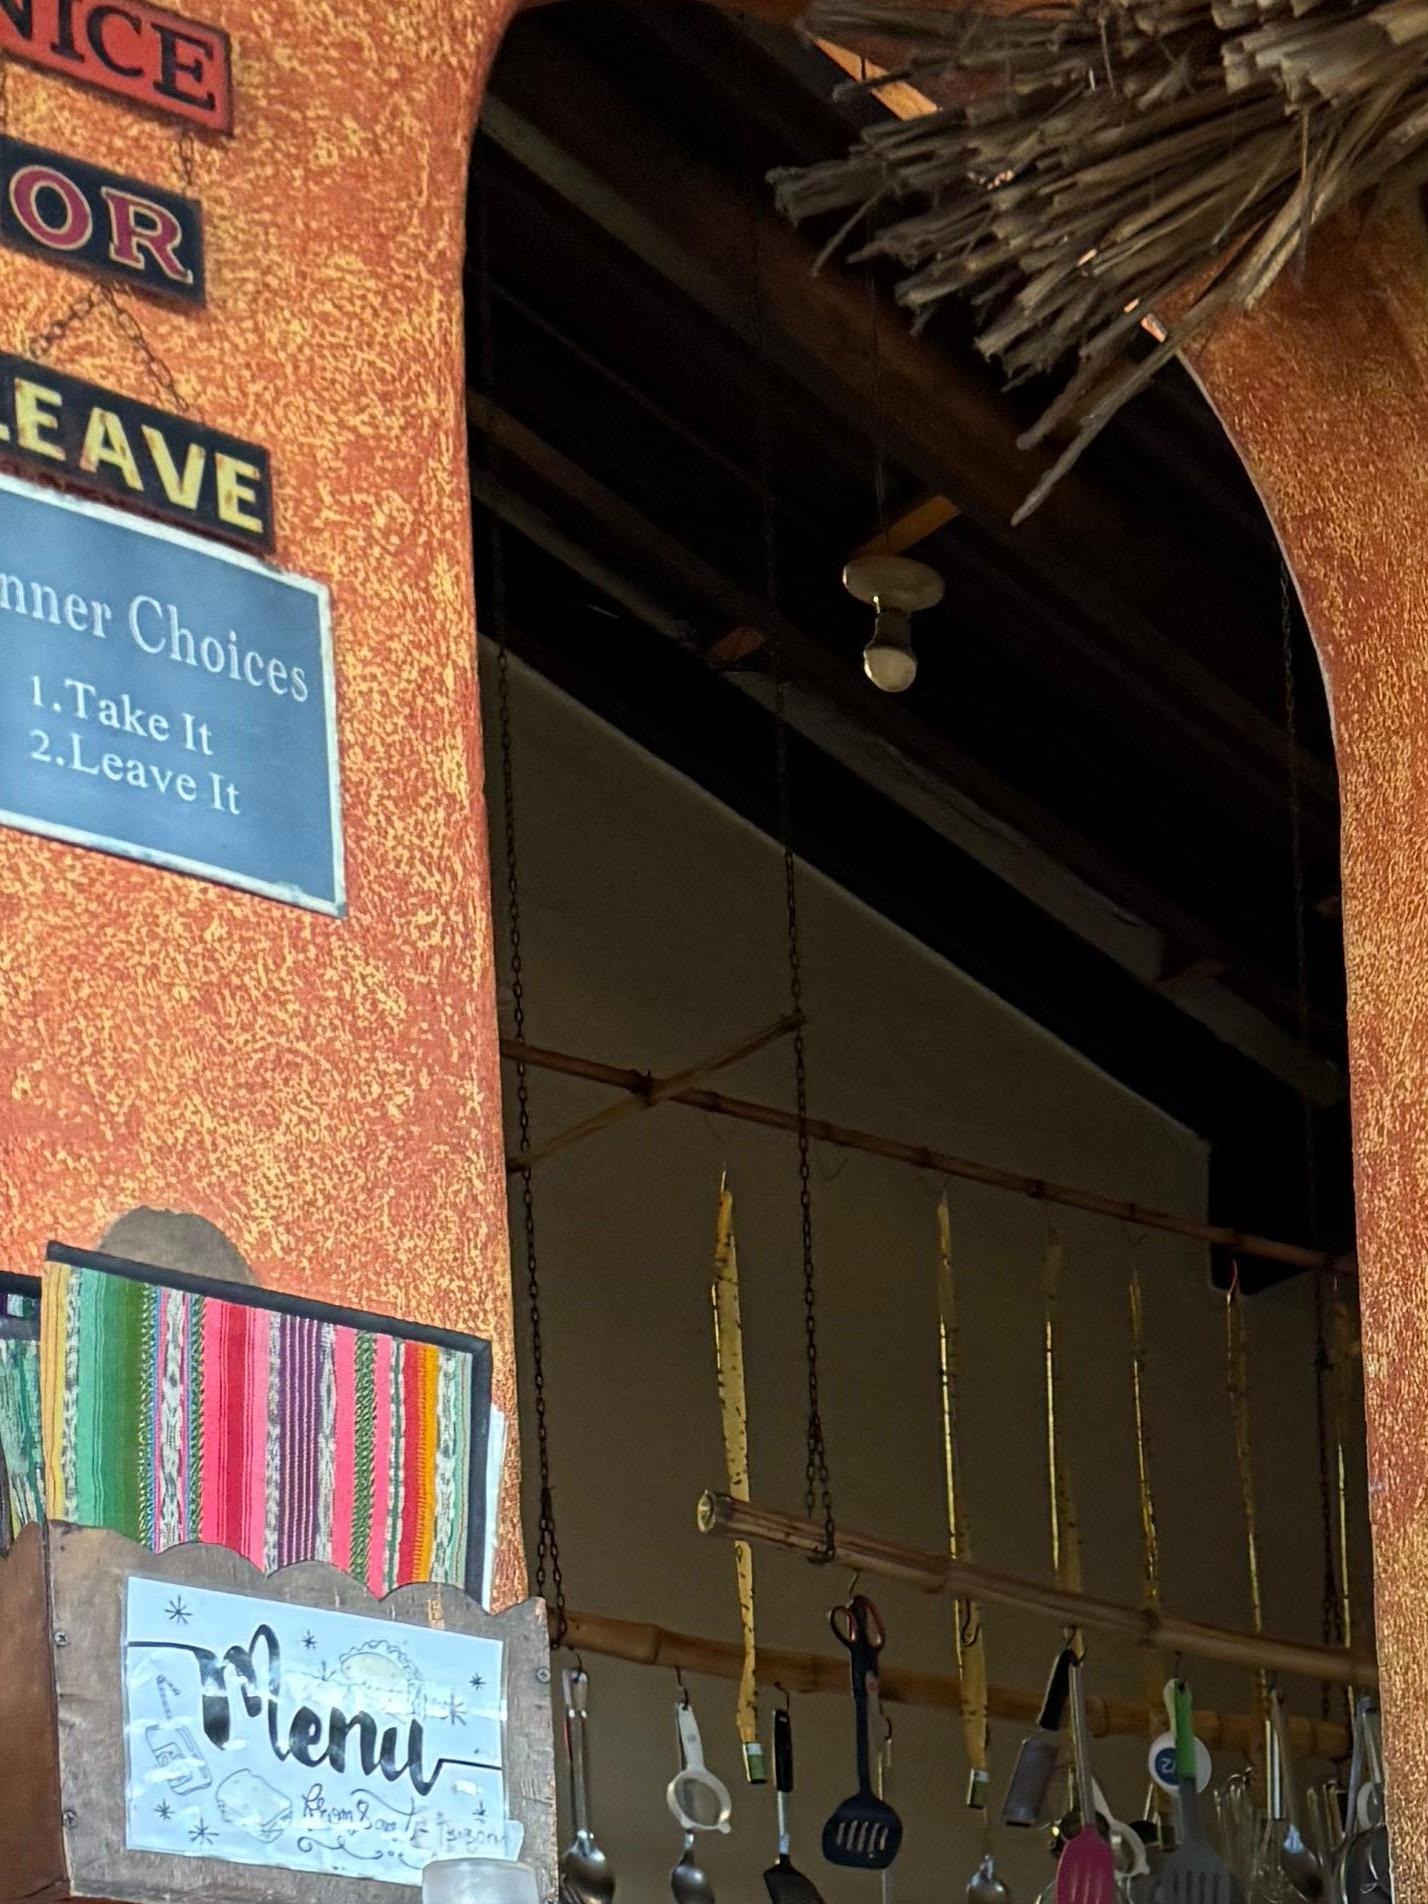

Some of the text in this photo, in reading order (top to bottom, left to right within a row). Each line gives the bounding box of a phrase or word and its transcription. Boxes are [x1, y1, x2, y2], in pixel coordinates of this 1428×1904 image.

[9, 165, 194, 285] OR
[0, 378, 264, 533] EAVE
[128, 595, 309, 702] Choices
[184, 713, 214, 756] It
[209, 773, 240, 815] It
[193, 1623, 443, 1797] Menu
